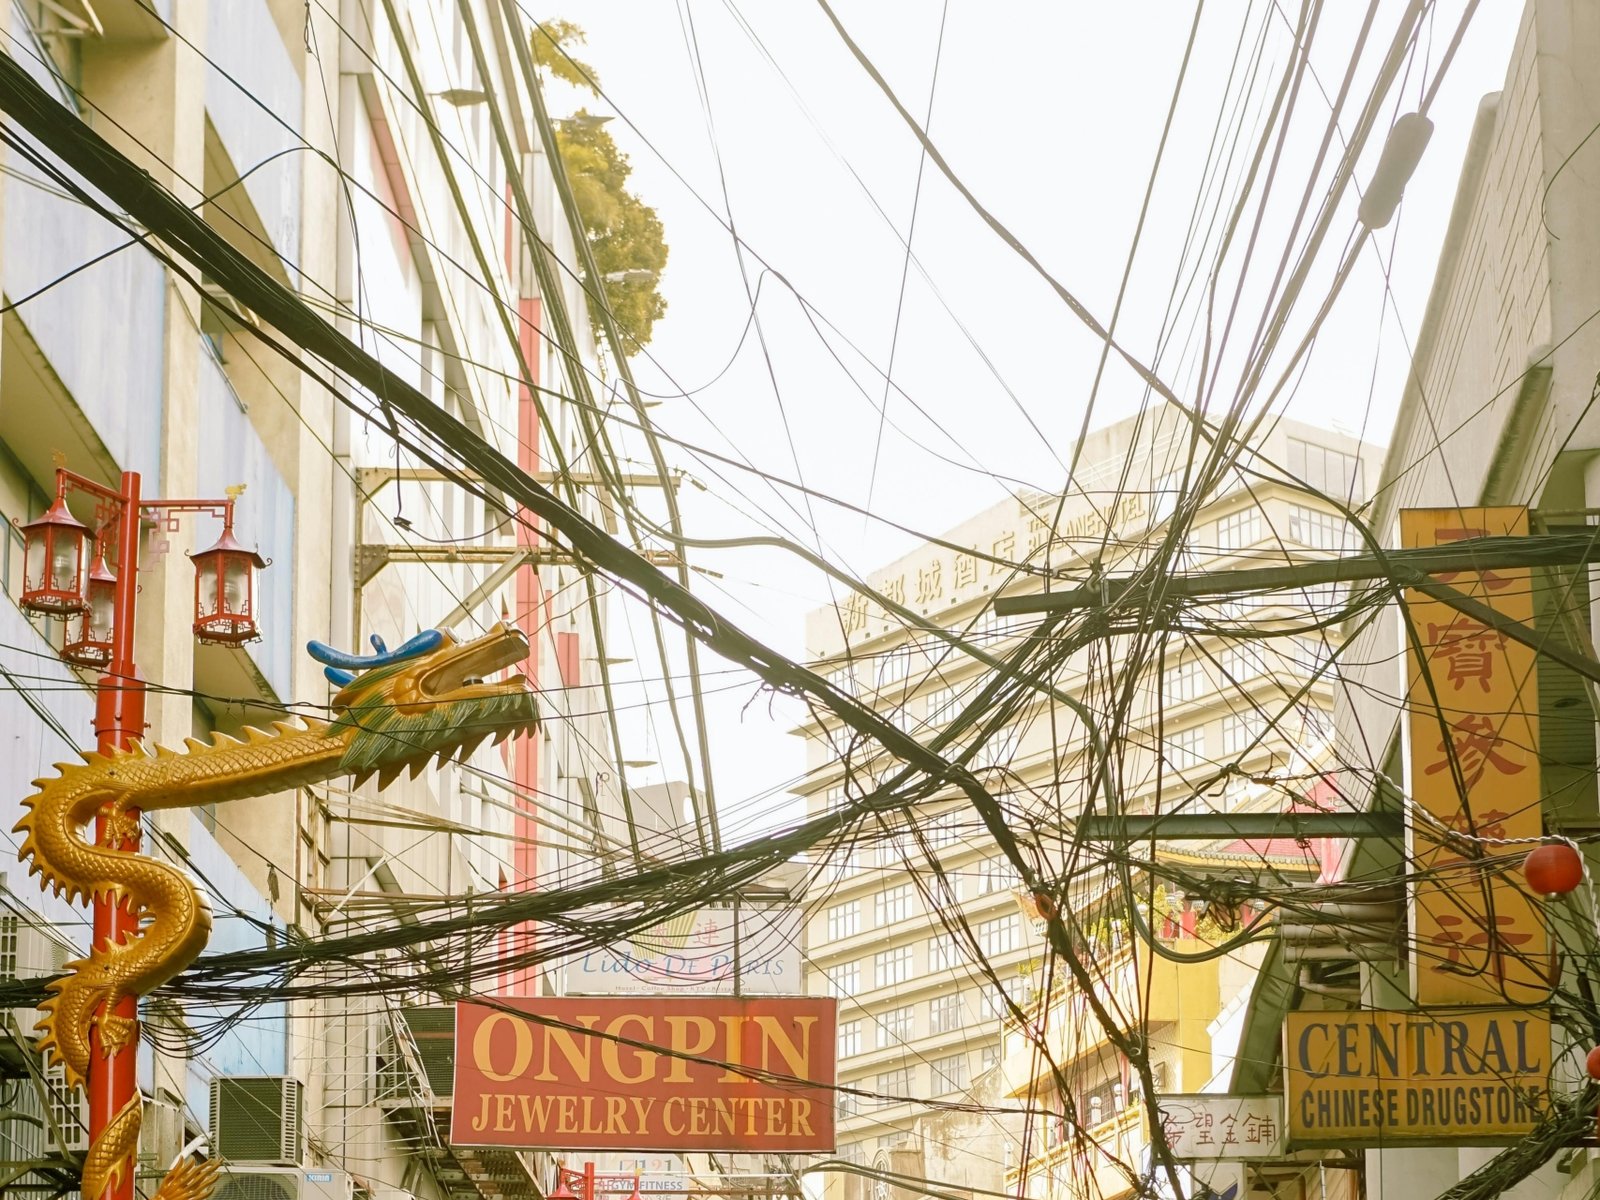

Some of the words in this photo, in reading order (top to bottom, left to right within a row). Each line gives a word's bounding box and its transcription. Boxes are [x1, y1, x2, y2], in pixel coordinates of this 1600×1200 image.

[472, 1012, 820, 1084] ONGPIN
[1297, 1019, 1541, 1079] CENTRAL
[472, 1093, 656, 1136] JEWELRY
[662, 1095, 816, 1137] CENTER
[1301, 1088, 1398, 1128] CHINESE
[1406, 1085, 1541, 1127] DRUGSTORE
[640, 1181, 683, 1190] FITNESS
